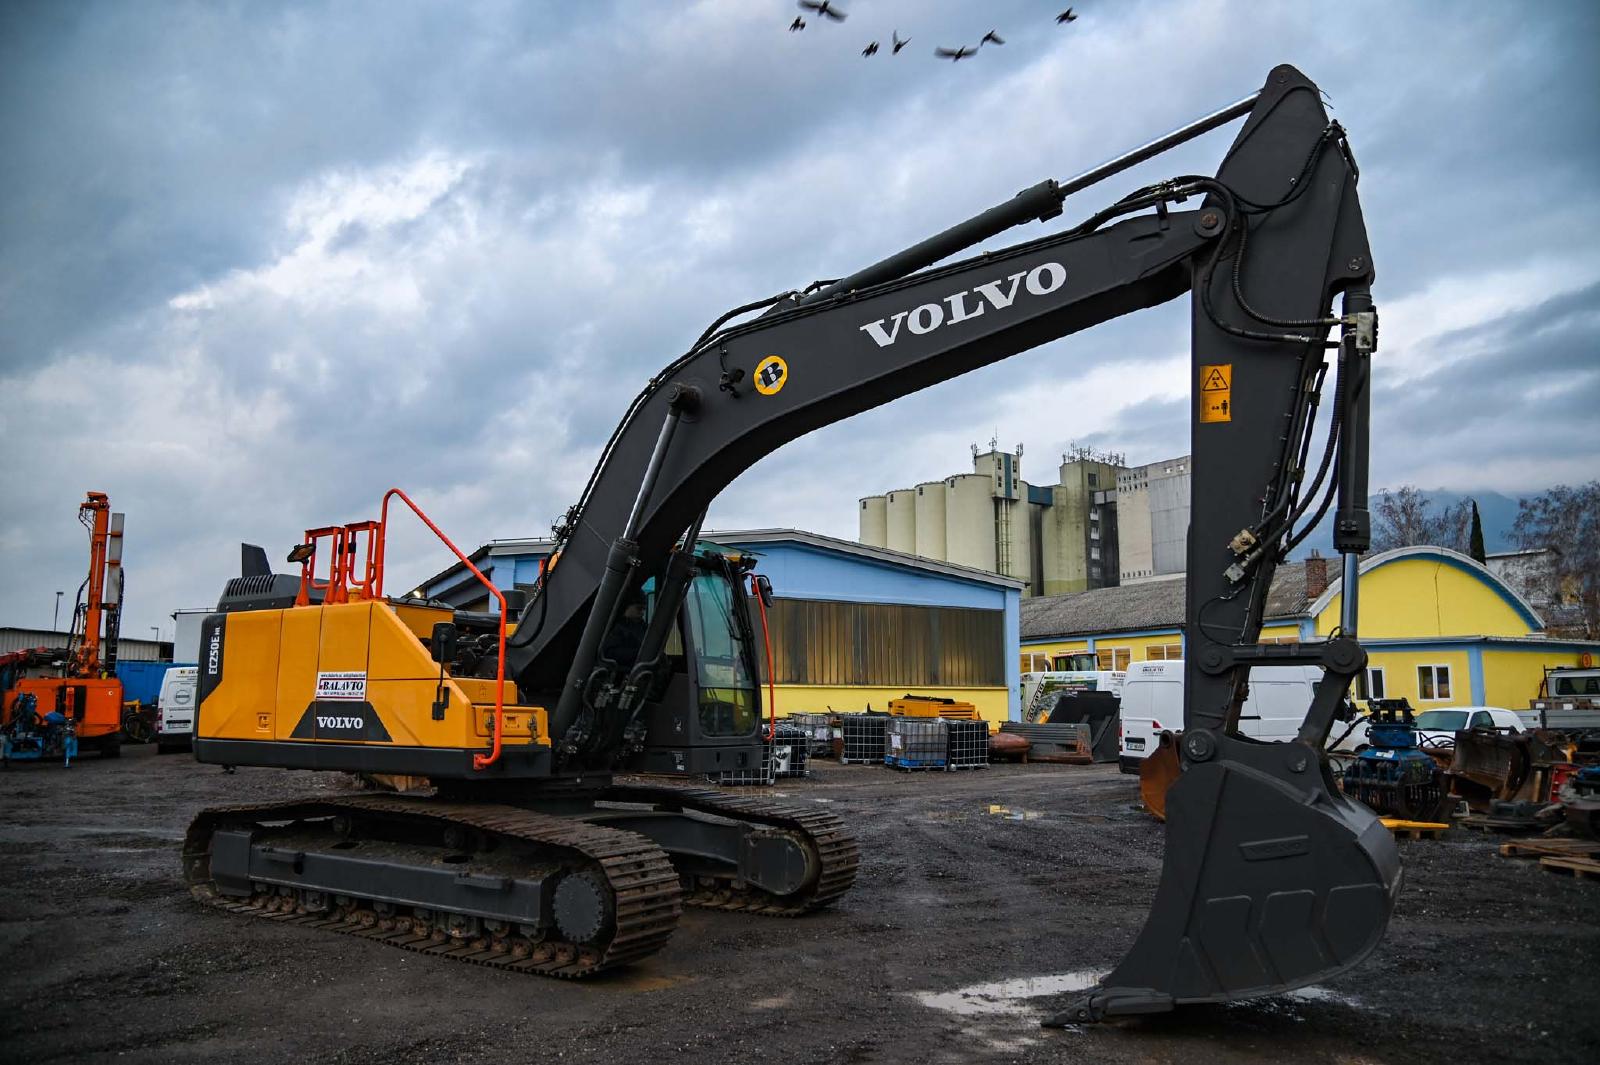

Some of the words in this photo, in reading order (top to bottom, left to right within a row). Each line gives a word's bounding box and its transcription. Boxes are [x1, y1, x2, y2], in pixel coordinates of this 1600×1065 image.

[859, 262, 1067, 348] VOLVO
[208, 635, 220, 675] EC250E
[316, 716, 364, 729] VOLVO
